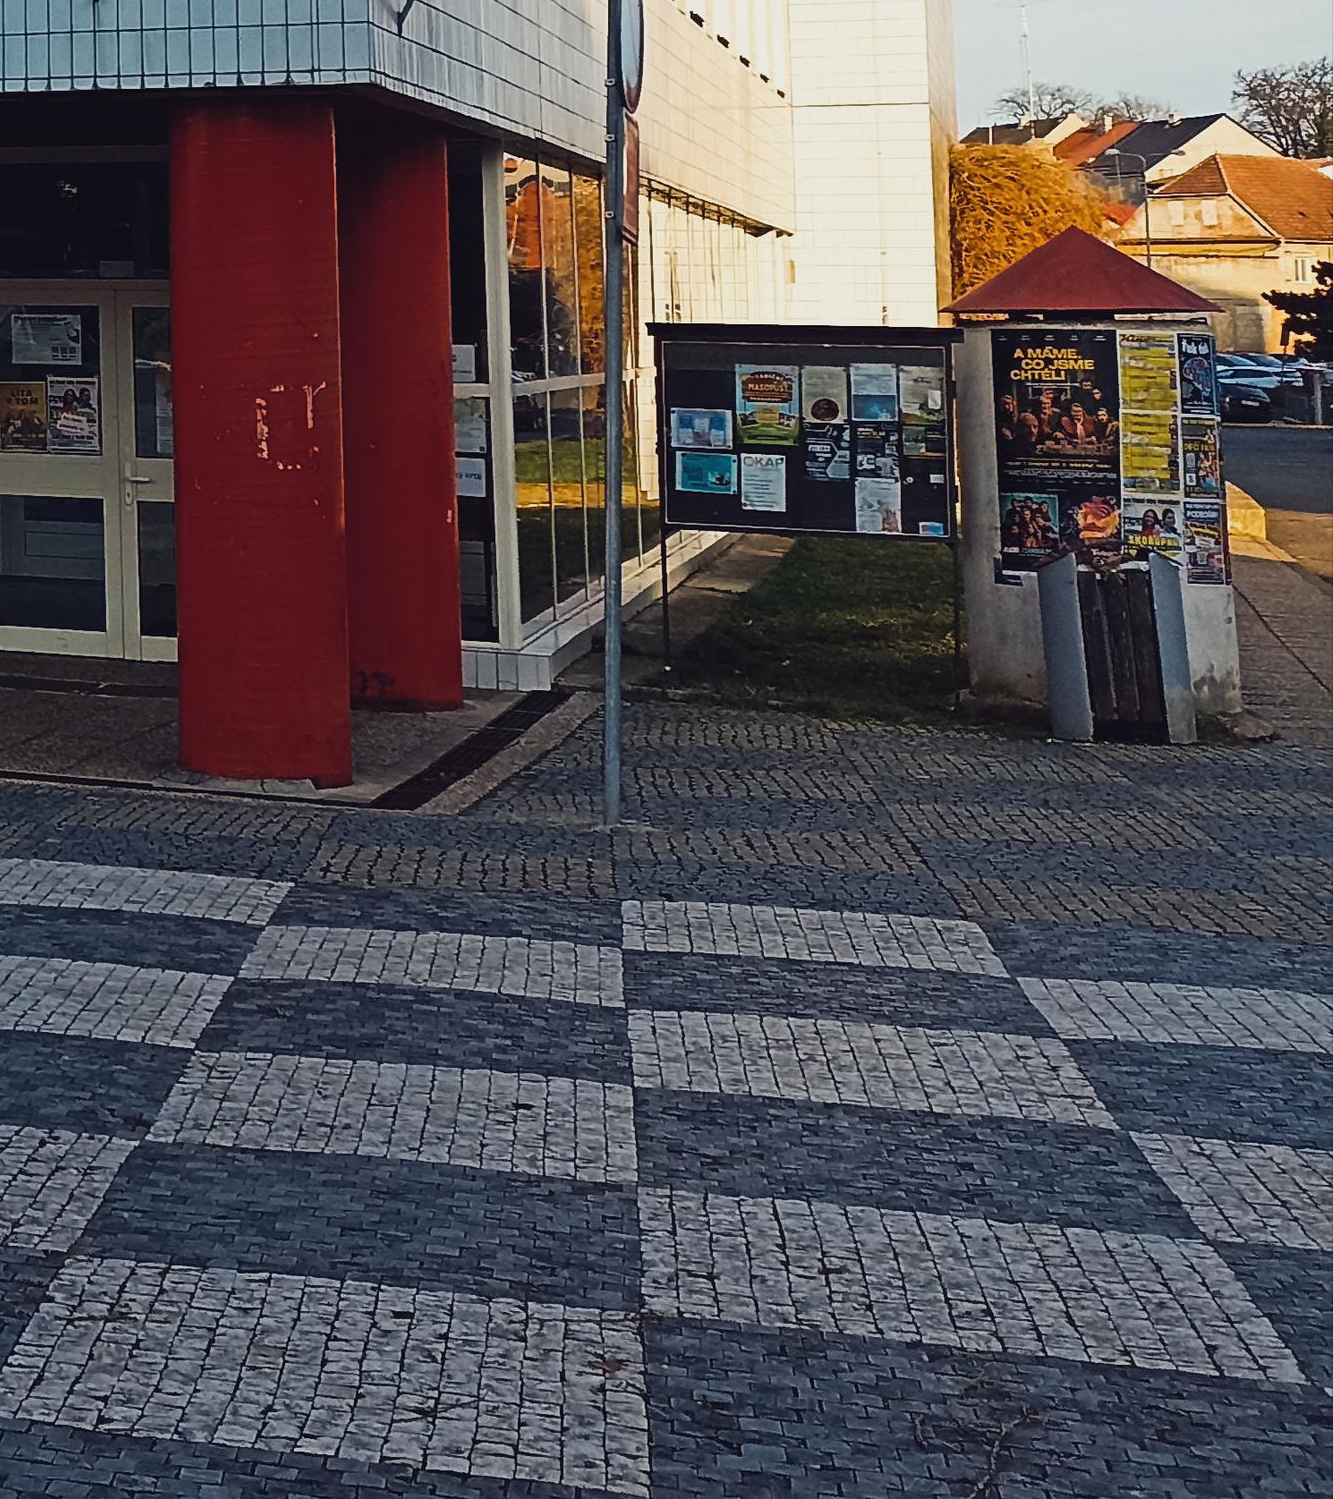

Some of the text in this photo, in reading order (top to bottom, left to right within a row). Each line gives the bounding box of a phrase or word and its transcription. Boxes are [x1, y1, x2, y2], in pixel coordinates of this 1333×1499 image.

[1014, 348, 1024, 358] A
[1021, 359, 1095, 370] CO JSME
[743, 456, 783, 468] OKAP
